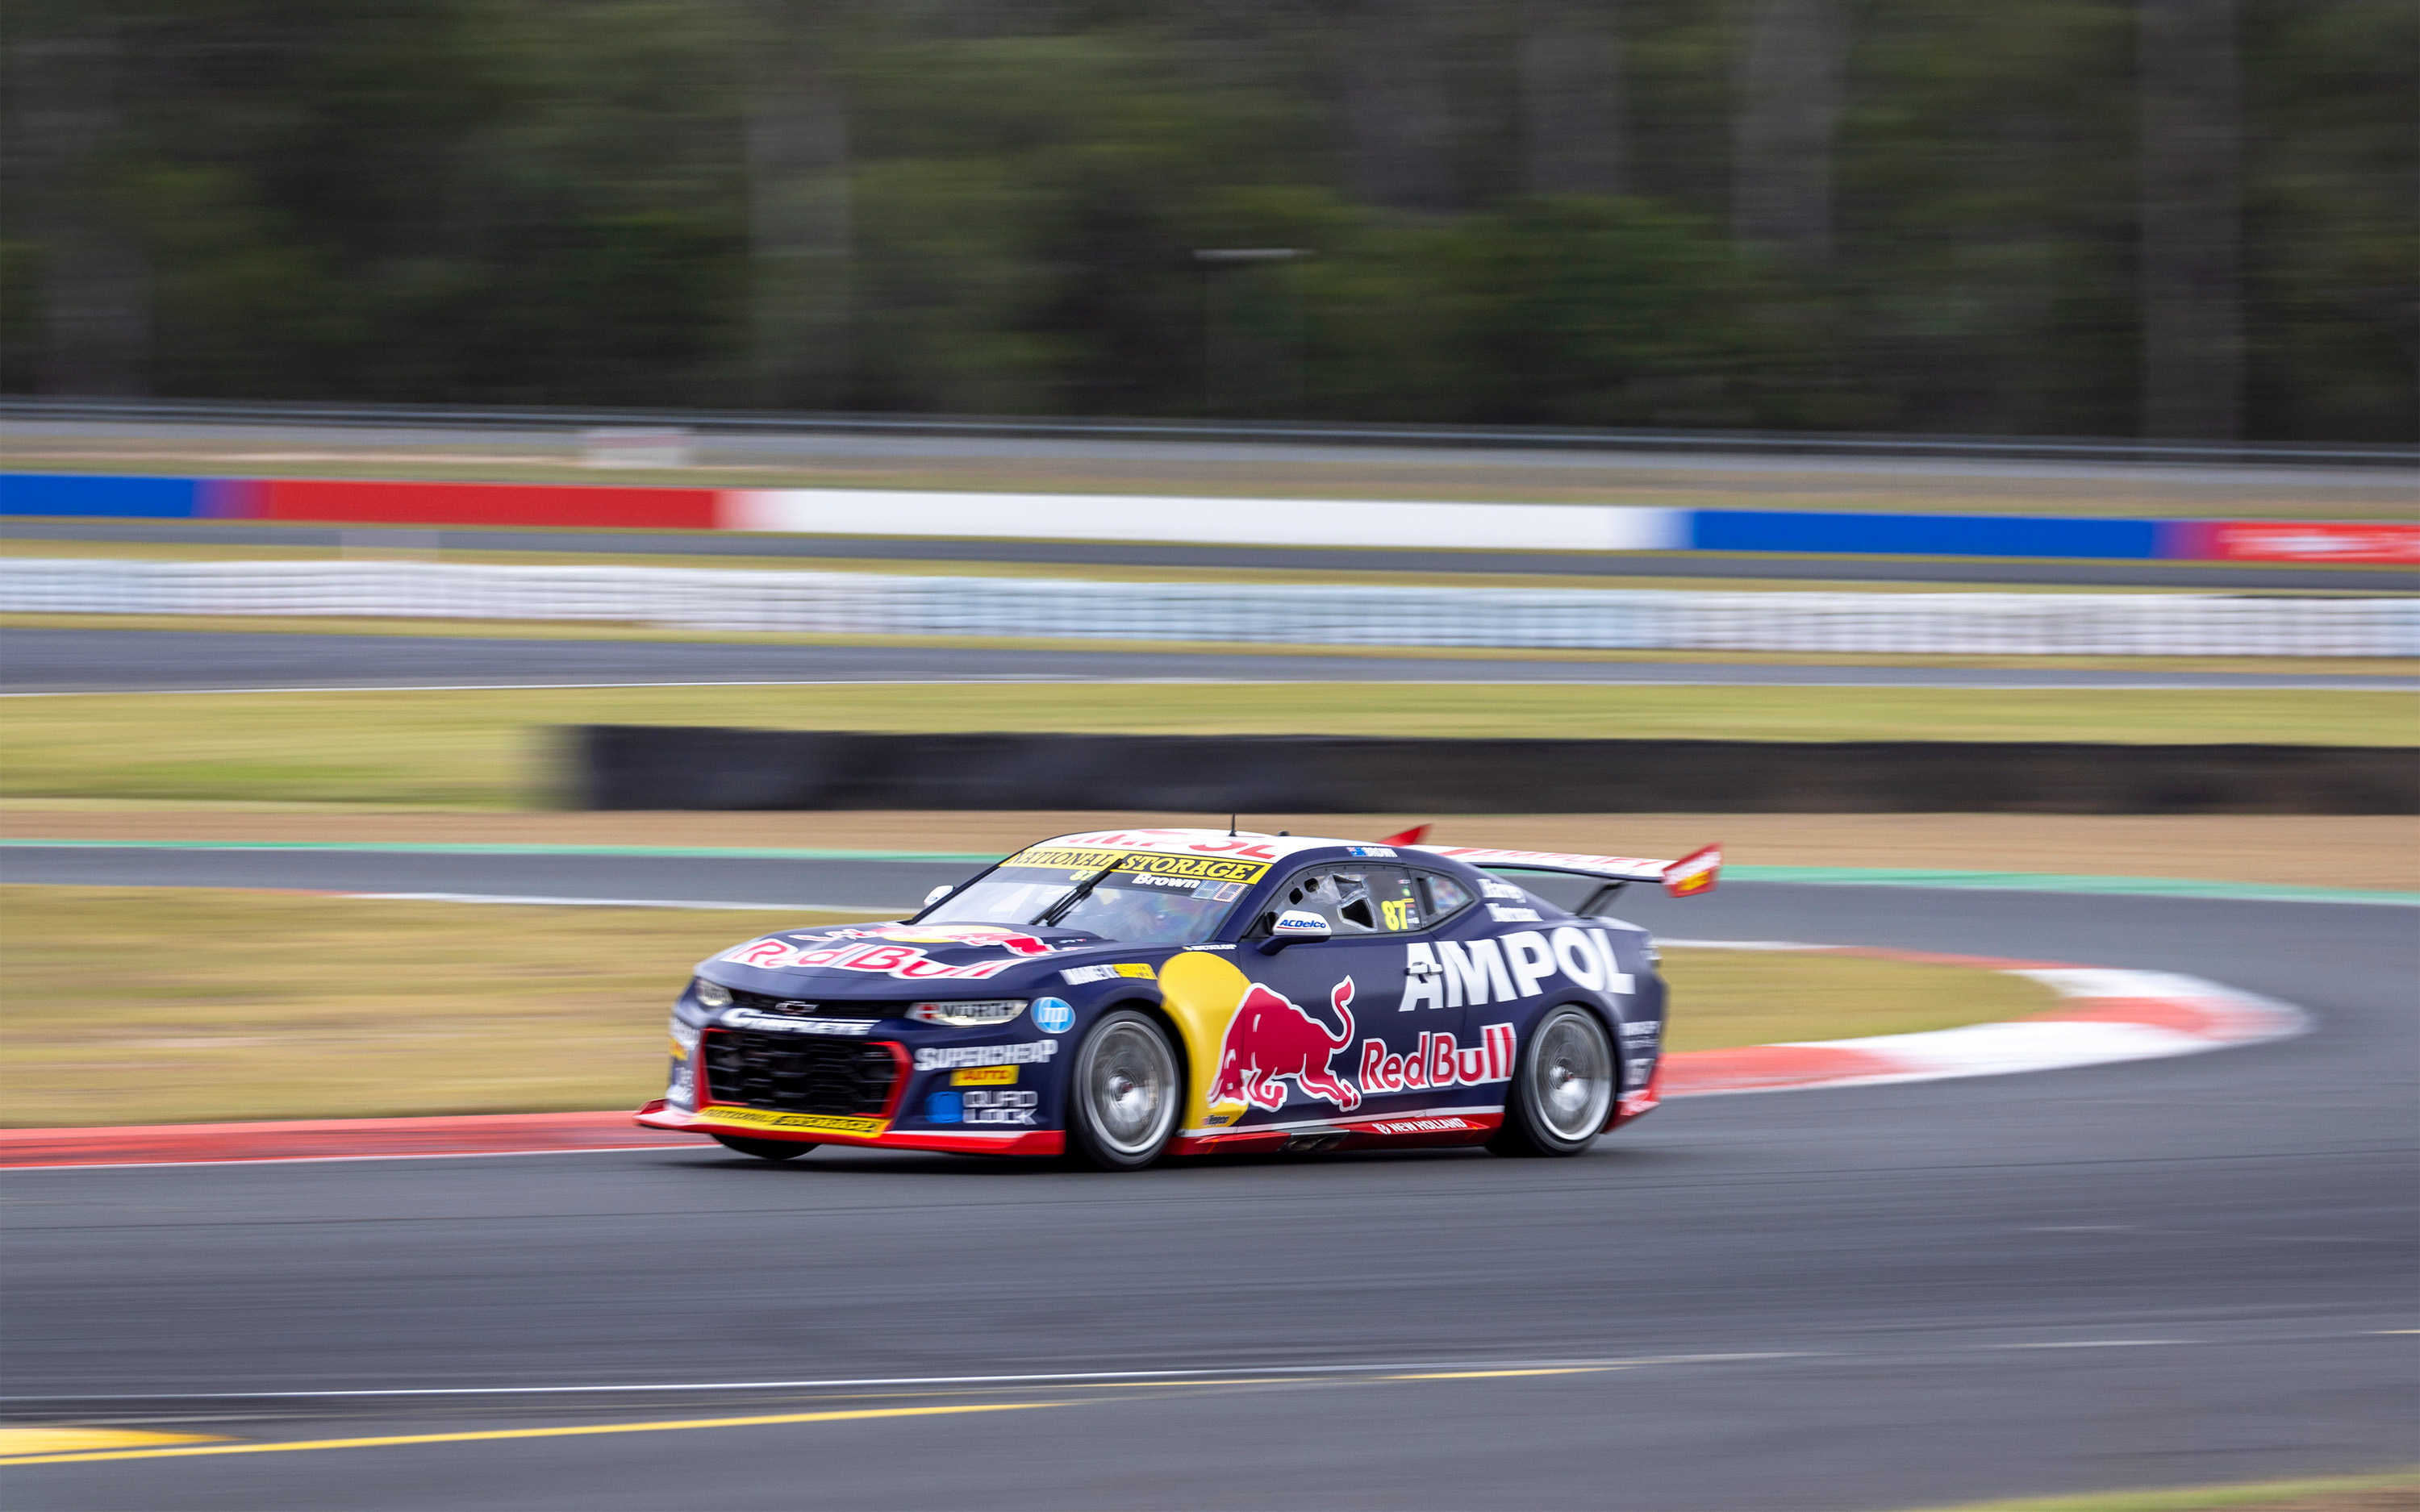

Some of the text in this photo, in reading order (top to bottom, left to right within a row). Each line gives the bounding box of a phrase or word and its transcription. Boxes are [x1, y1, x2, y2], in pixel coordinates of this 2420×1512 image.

[1008, 852, 1256, 880] NATIONAL STORAGE
[1132, 873, 1201, 889] Brown
[1279, 919, 1326, 928] ACDelco
[1381, 901, 1408, 931] 87
[1399, 927, 1636, 1011] AMPOL
[913, 1039, 1058, 1071] SUPERCHEAP
[1386, 1118, 1467, 1132] NEW HOLLAND
